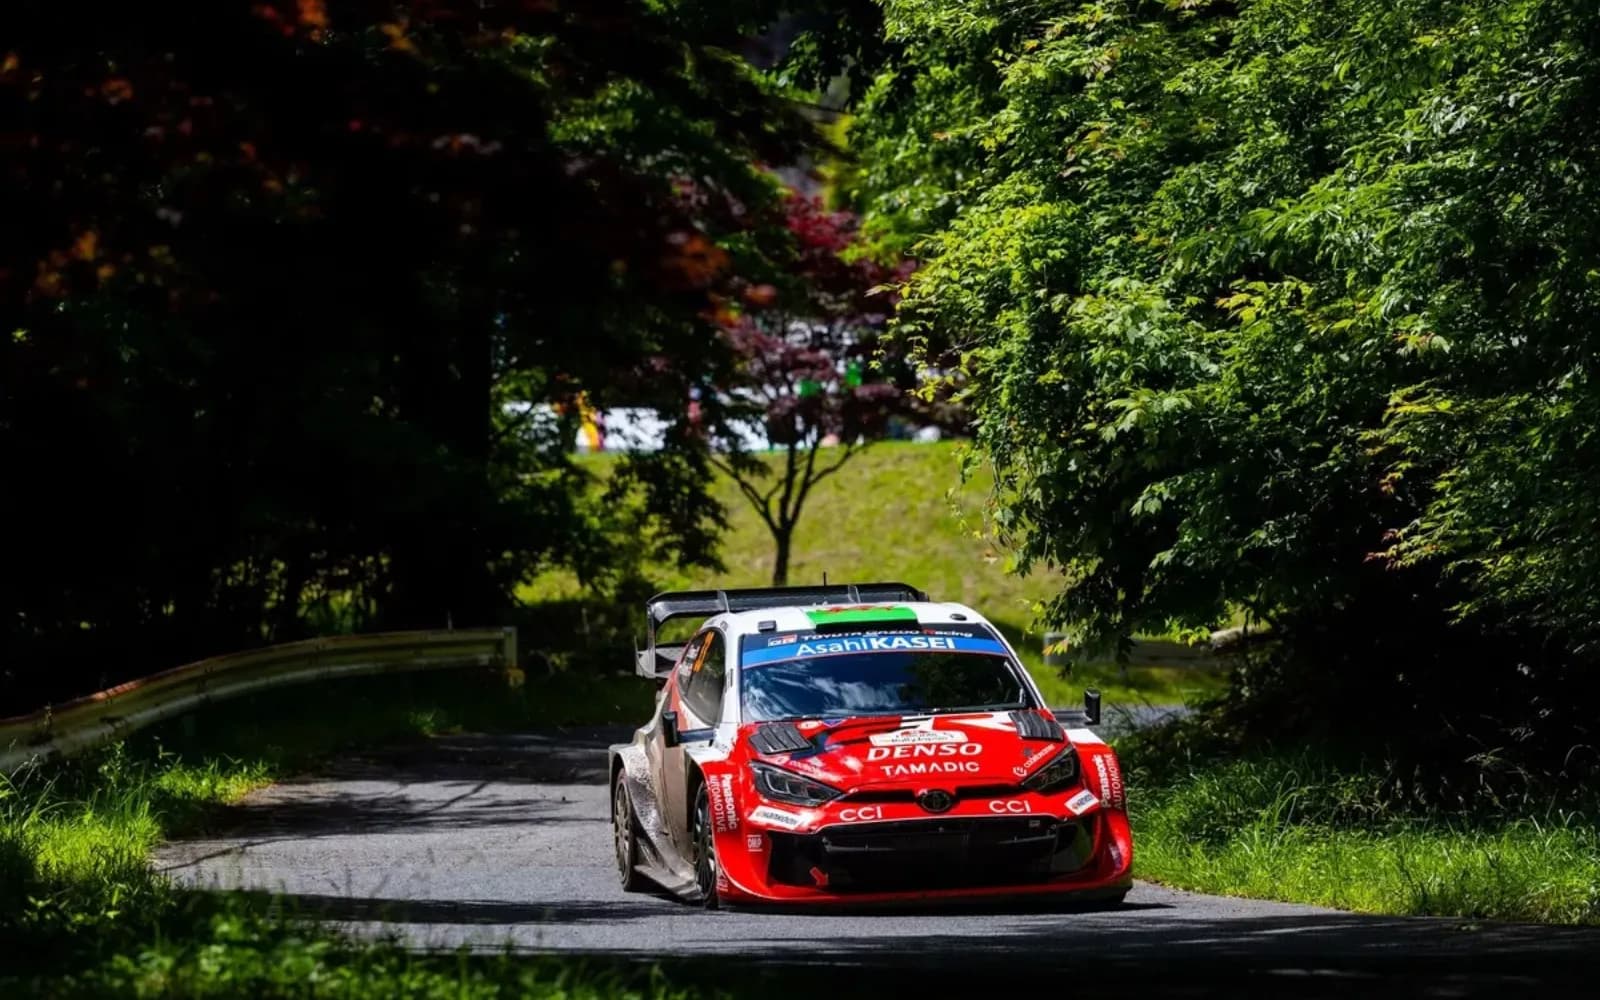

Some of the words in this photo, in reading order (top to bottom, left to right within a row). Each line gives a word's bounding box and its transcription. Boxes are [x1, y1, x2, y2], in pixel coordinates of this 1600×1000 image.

[867, 743, 982, 761] DENSO
[880, 761, 980, 776] TAMADIC
[721, 773, 740, 830] Panasonic
[988, 800, 1032, 814] CCI
[839, 806, 883, 822] CCI
